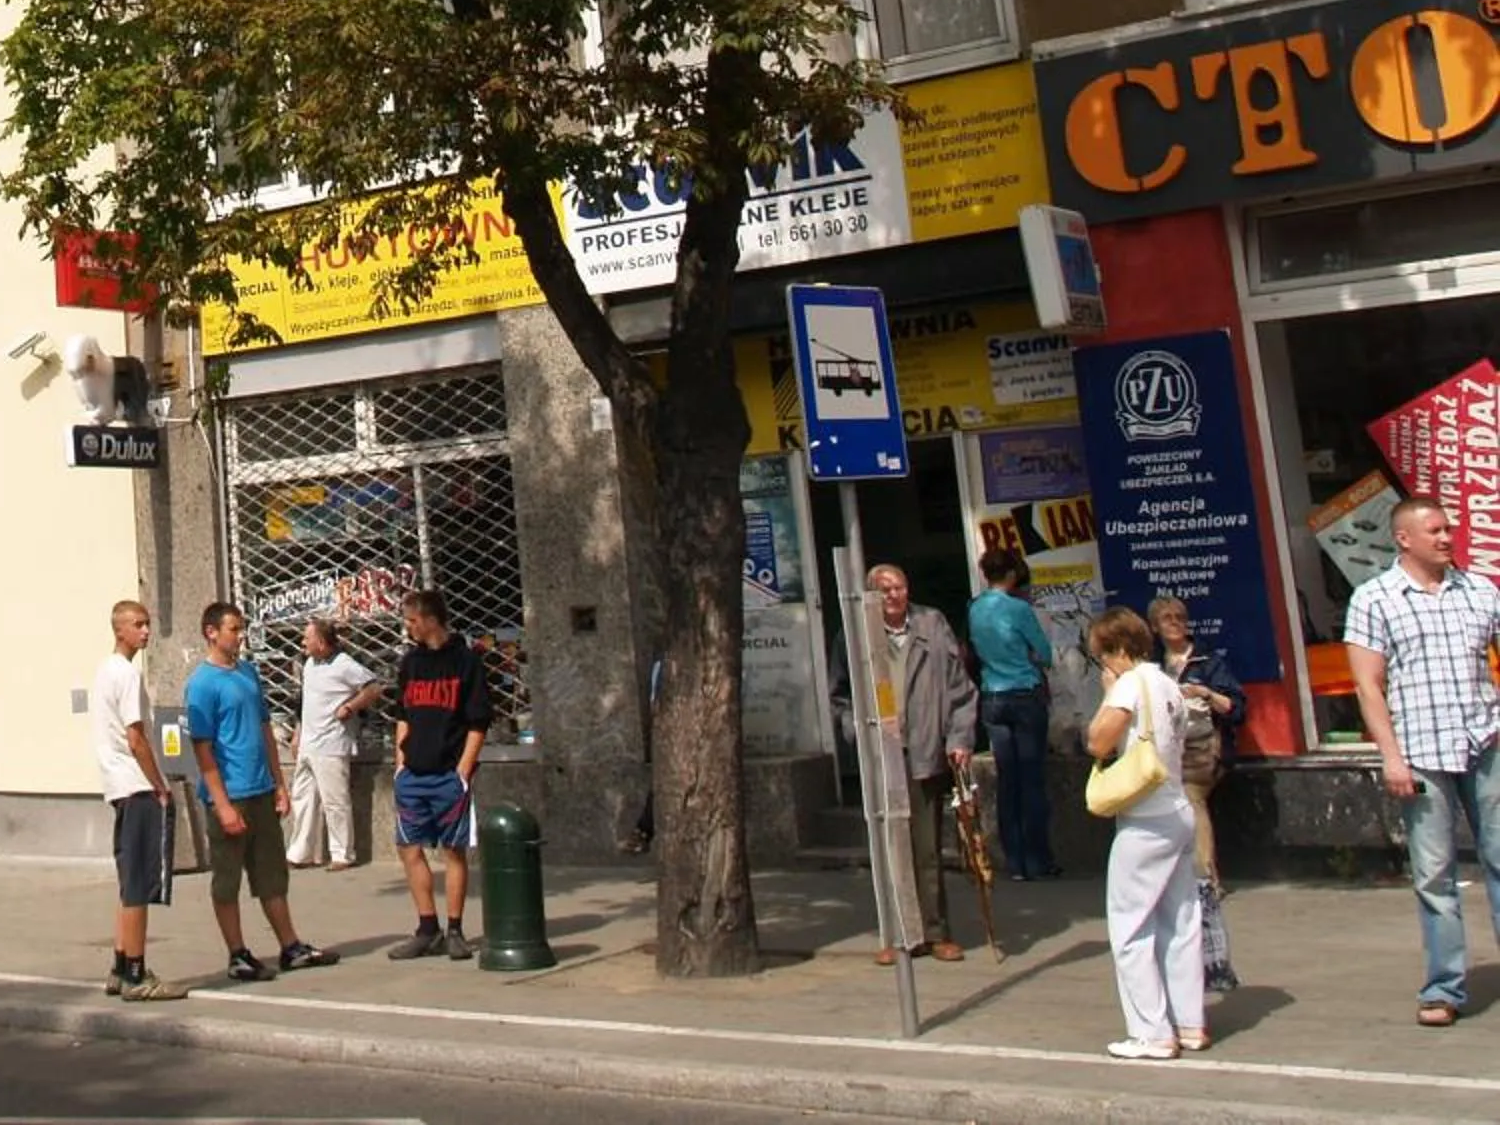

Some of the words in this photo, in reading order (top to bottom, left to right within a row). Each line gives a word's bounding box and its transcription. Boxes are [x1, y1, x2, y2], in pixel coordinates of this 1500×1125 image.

[789, 186, 869, 218] KLEJE
[758, 227, 783, 249] tel.
[789, 221, 818, 243] 661
[823, 217, 843, 239] 30
[848, 214, 869, 235] 30
[1128, 367, 1183, 414] PZU
[100, 433, 156, 461] Dulux
[1127, 448, 1203, 465] POWSZECHNY
[1137, 495, 1206, 517] Agencja
[1104, 513, 1248, 537] Ubezpieczeniowa
[1131, 553, 1229, 571] Komunikacyjne
[1148, 569, 1216, 585] Majątkowe
[1176, 585, 1209, 600] życie
